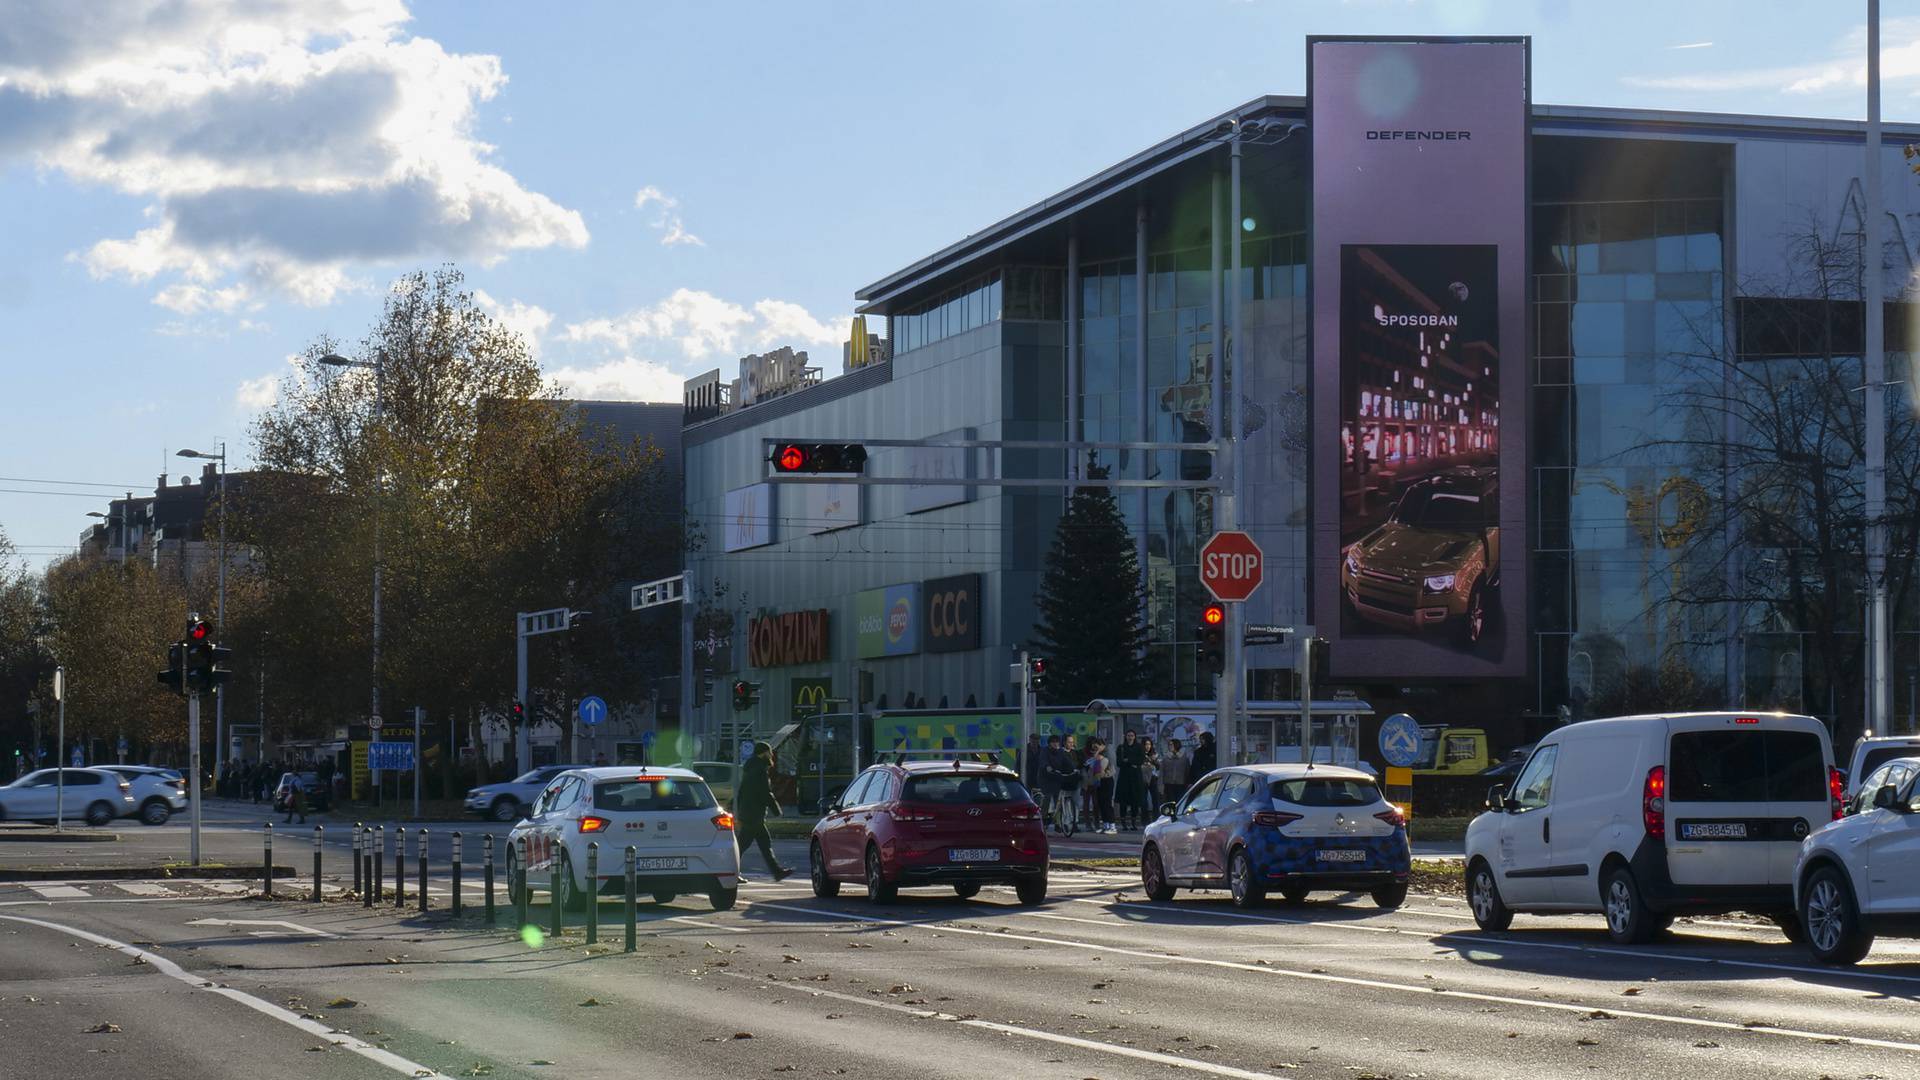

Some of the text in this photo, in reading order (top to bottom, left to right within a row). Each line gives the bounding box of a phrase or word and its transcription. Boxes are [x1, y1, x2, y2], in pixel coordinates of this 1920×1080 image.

[1365, 131, 1472, 141] DEFENDER
[1379, 314, 1459, 327] SPOSOBAN
[1206, 552, 1258, 580] STOP
[889, 612, 908, 628] PEPCO
[930, 589, 968, 638] CCC
[748, 611, 825, 668] KONZUM
